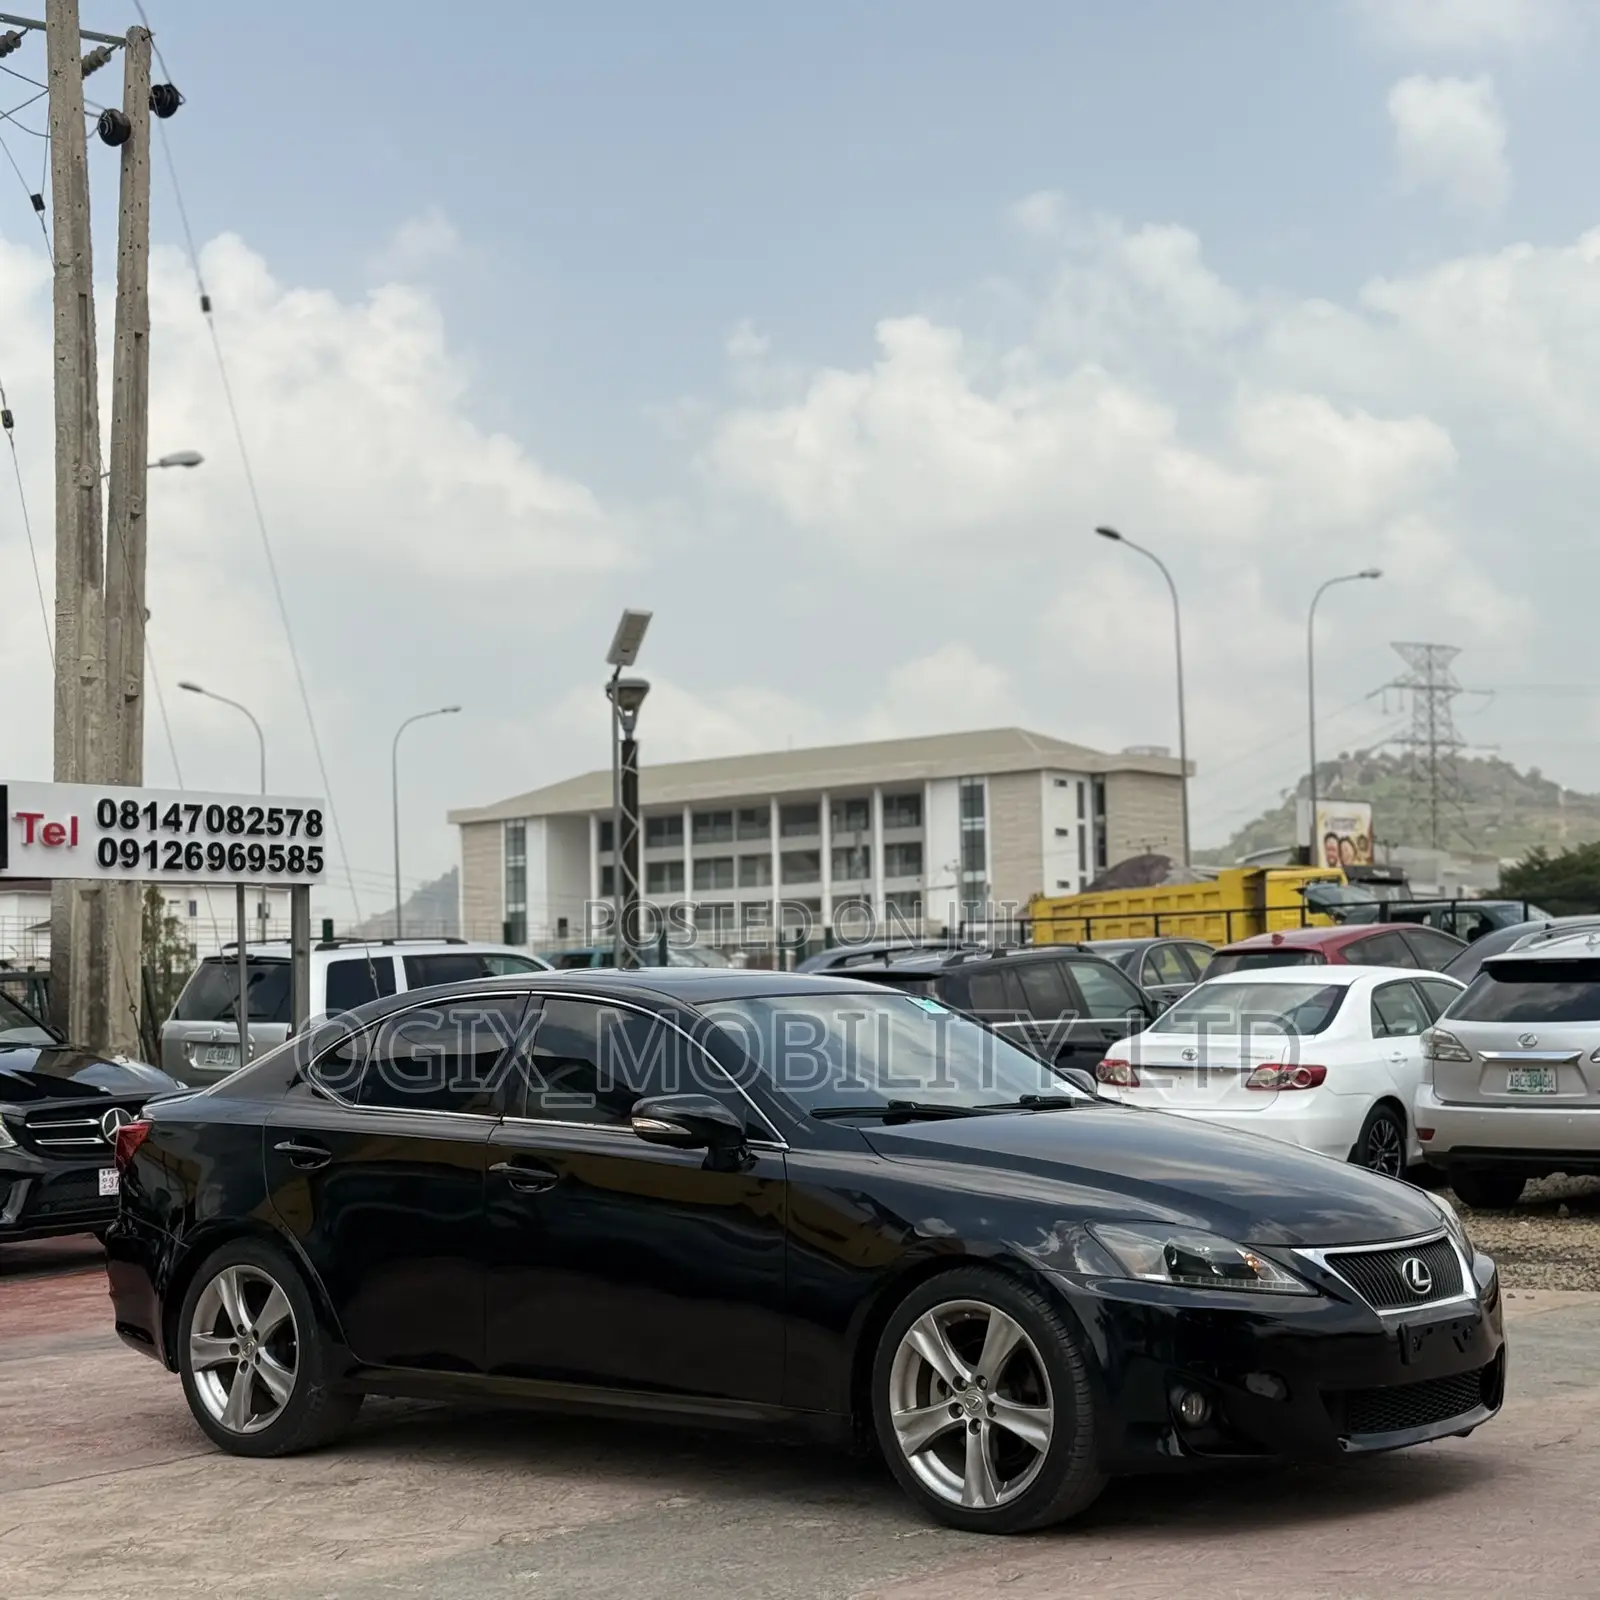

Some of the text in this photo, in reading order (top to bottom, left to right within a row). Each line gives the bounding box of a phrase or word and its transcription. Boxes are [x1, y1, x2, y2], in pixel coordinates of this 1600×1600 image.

[14, 811, 78, 846] Tel
[97, 798, 323, 837] 08147082578
[97, 837, 324, 874] 09126969585
